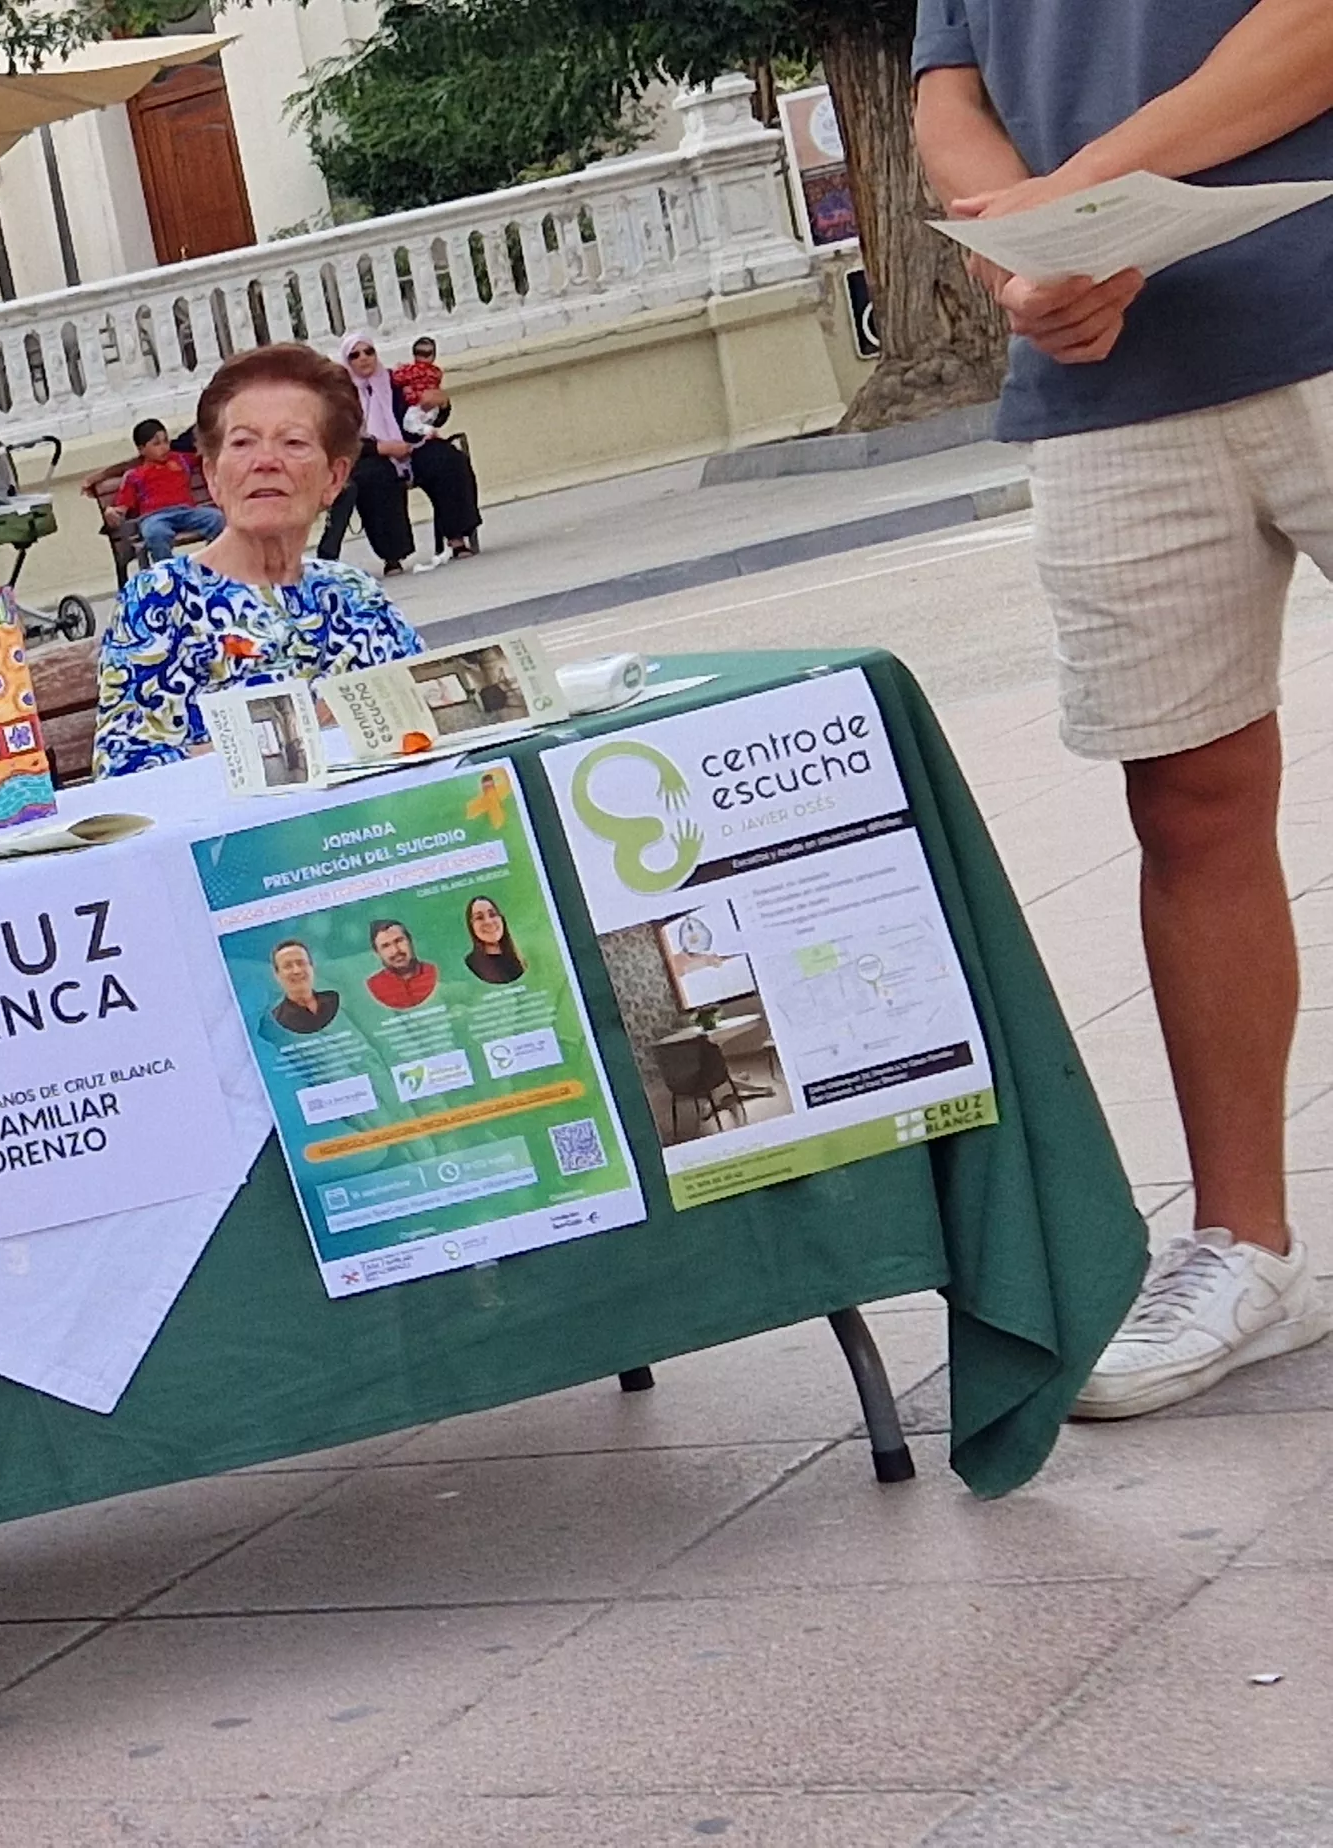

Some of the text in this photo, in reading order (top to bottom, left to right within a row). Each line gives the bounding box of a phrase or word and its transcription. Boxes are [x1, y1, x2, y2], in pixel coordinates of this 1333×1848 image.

[701, 712, 871, 779] centro de
[712, 748, 873, 811] escucha
[321, 820, 396, 852] JORNADA
[740, 810, 789, 832] JAVIER
[262, 827, 467, 891] PREVENCIÓN DEL SUICIDIO
[41, 1082, 61, 1099] DE
[64, 1072, 106, 1095] CRUZ
[110, 1057, 177, 1084] BLANCA
[924, 1094, 985, 1122] CRUZ
[925, 1110, 985, 1135] BLANCA
